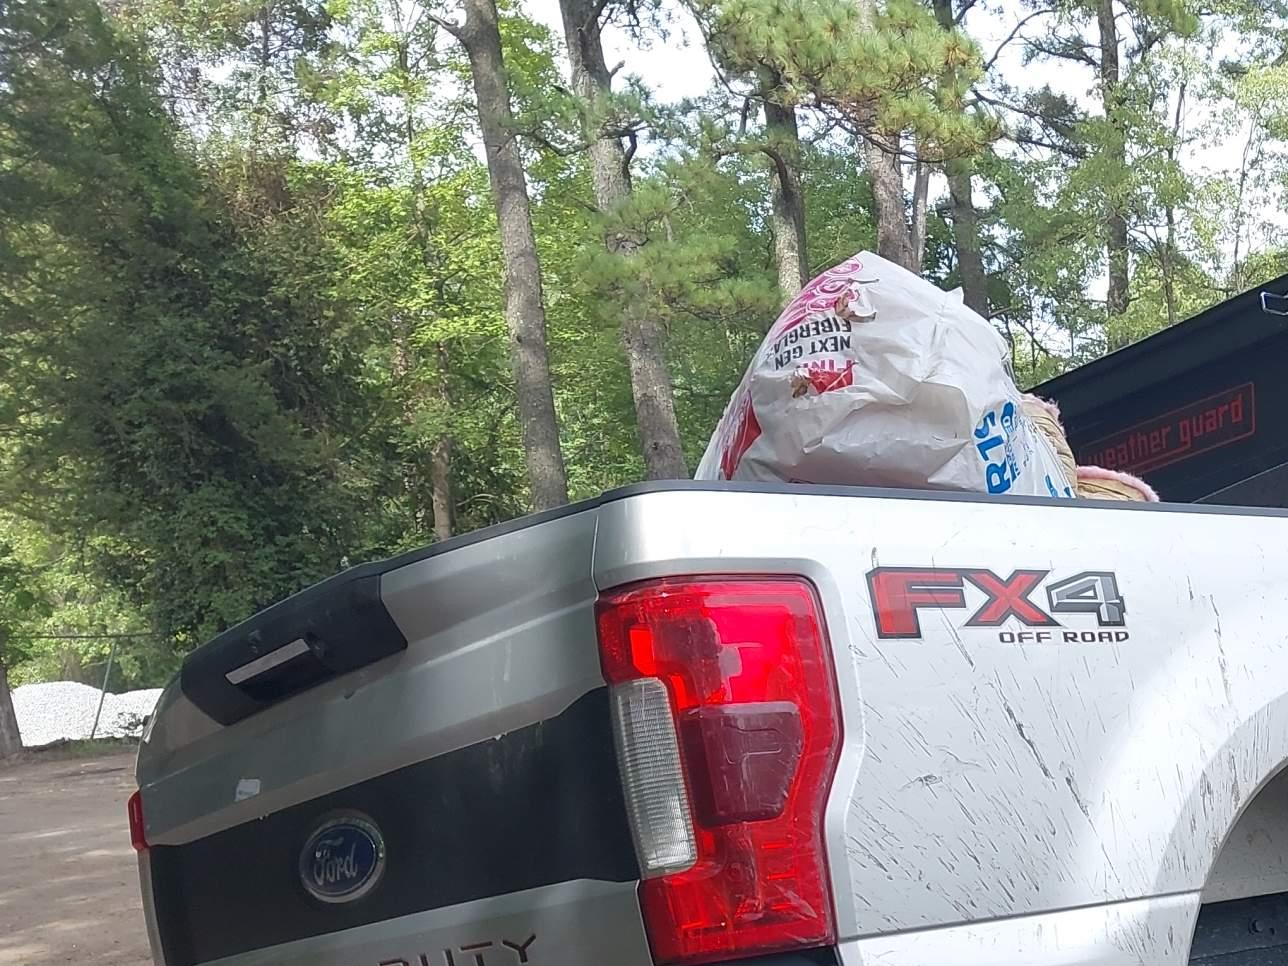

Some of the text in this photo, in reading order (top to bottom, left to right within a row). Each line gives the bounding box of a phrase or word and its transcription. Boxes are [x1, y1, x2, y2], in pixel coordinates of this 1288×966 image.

[767, 316, 852, 358] FIBERGLA
[775, 335, 851, 371] NEXT GEN
[1087, 424, 1171, 466] weather
[1179, 393, 1243, 444] guard
[866, 566, 1126, 640] FX4
[999, 631, 1130, 644] OFF ROAD
[313, 835, 359, 886] Ford
